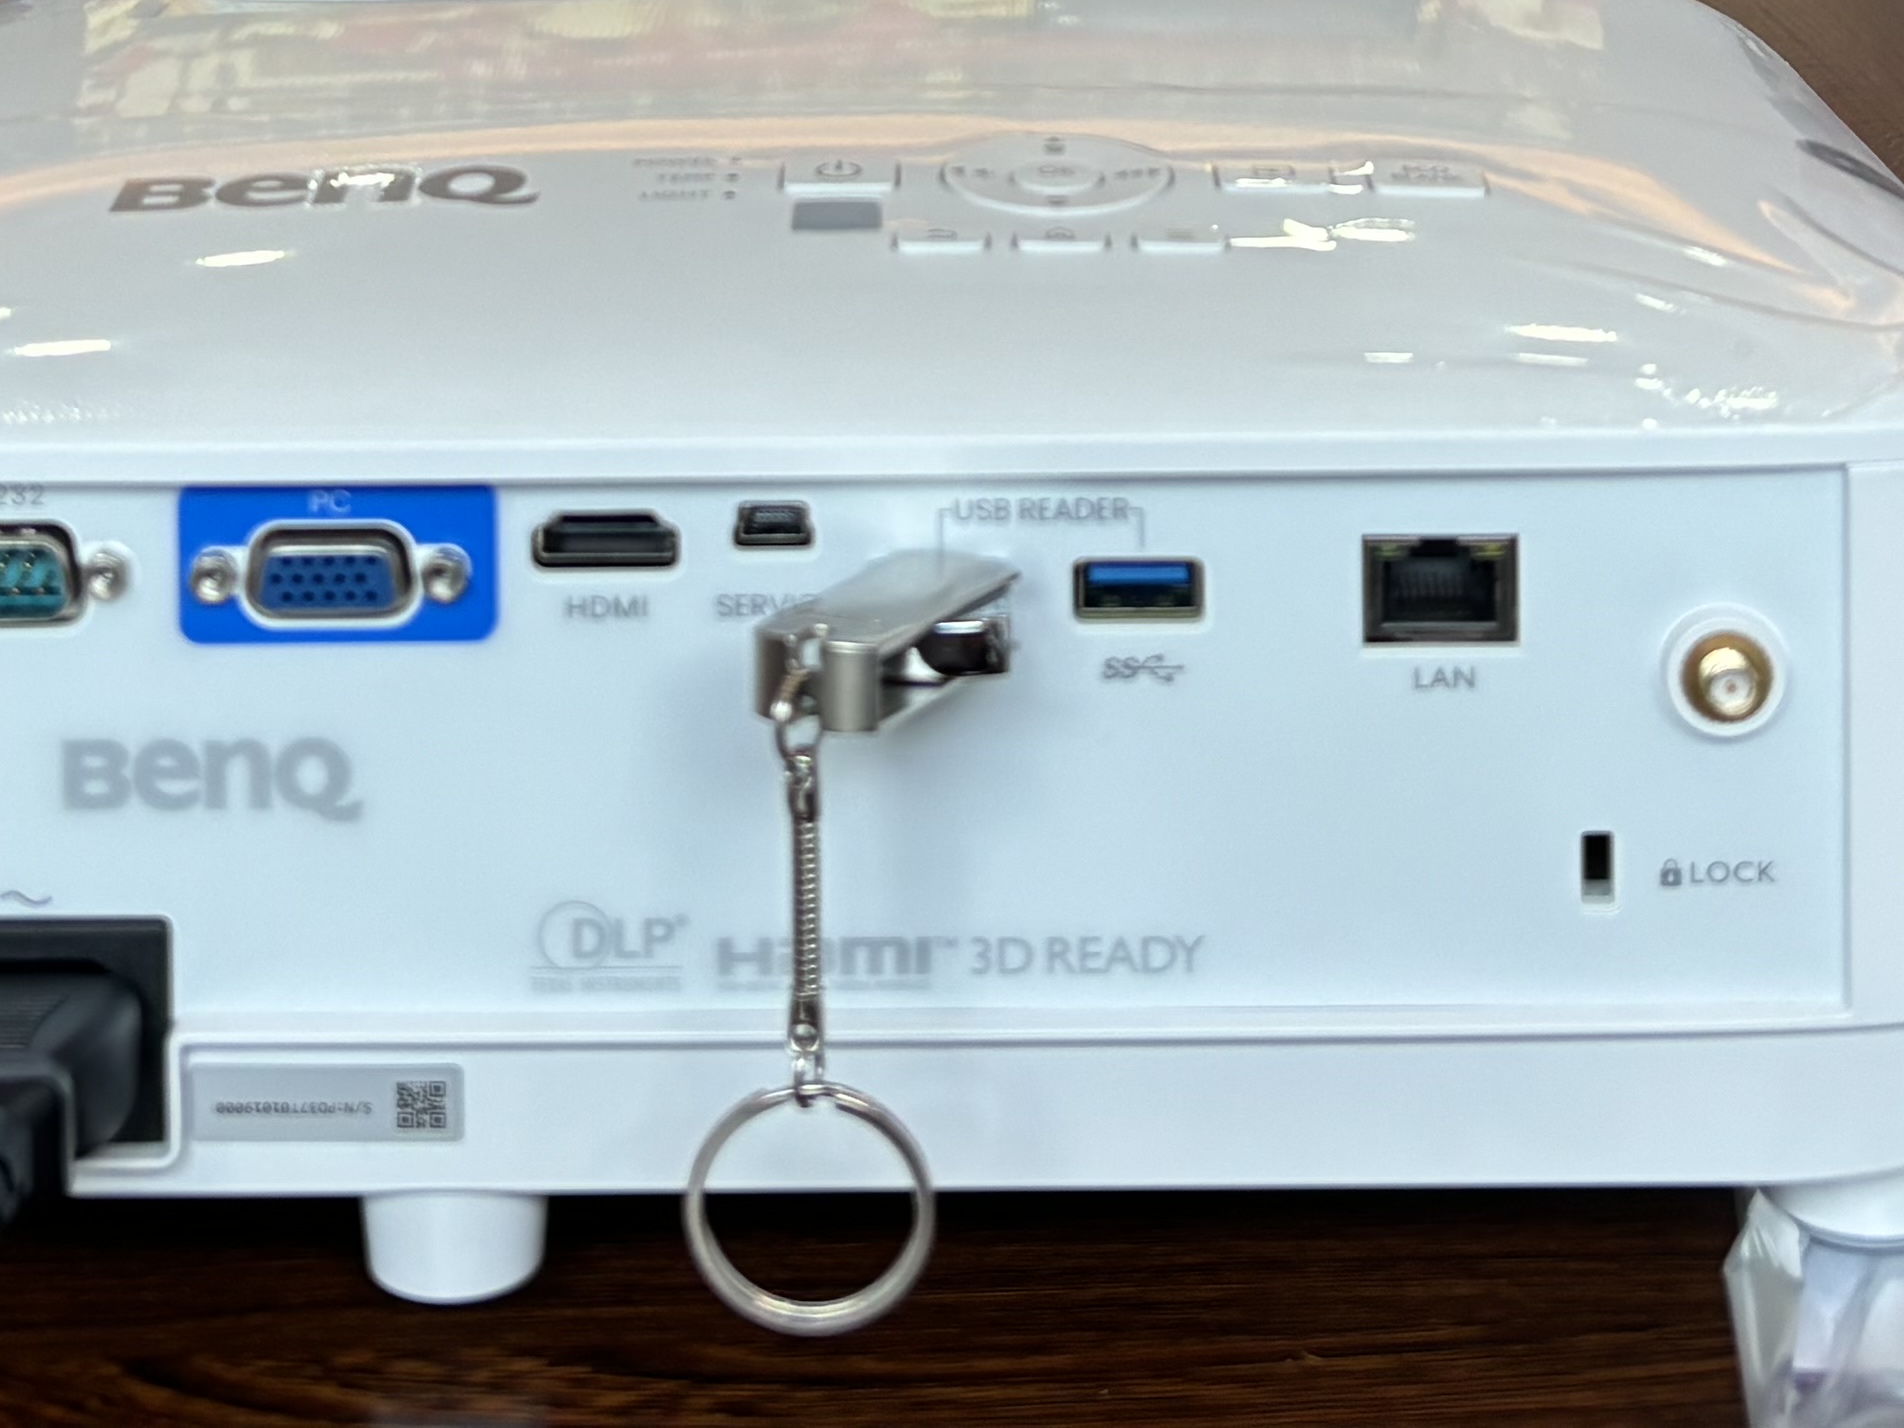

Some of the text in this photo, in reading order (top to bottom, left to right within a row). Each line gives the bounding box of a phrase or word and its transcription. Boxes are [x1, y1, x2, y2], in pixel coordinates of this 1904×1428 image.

[109, 163, 541, 213] BenQ
[307, 489, 353, 514] PC
[952, 497, 1130, 522] USB READER
[566, 594, 649, 620] HDMI
[1412, 665, 1477, 691] LAN
[61, 736, 365, 823] BenQ
[1689, 860, 1777, 884] LOCK
[969, 935, 1034, 975] 3D
[1044, 934, 1206, 975] READY
